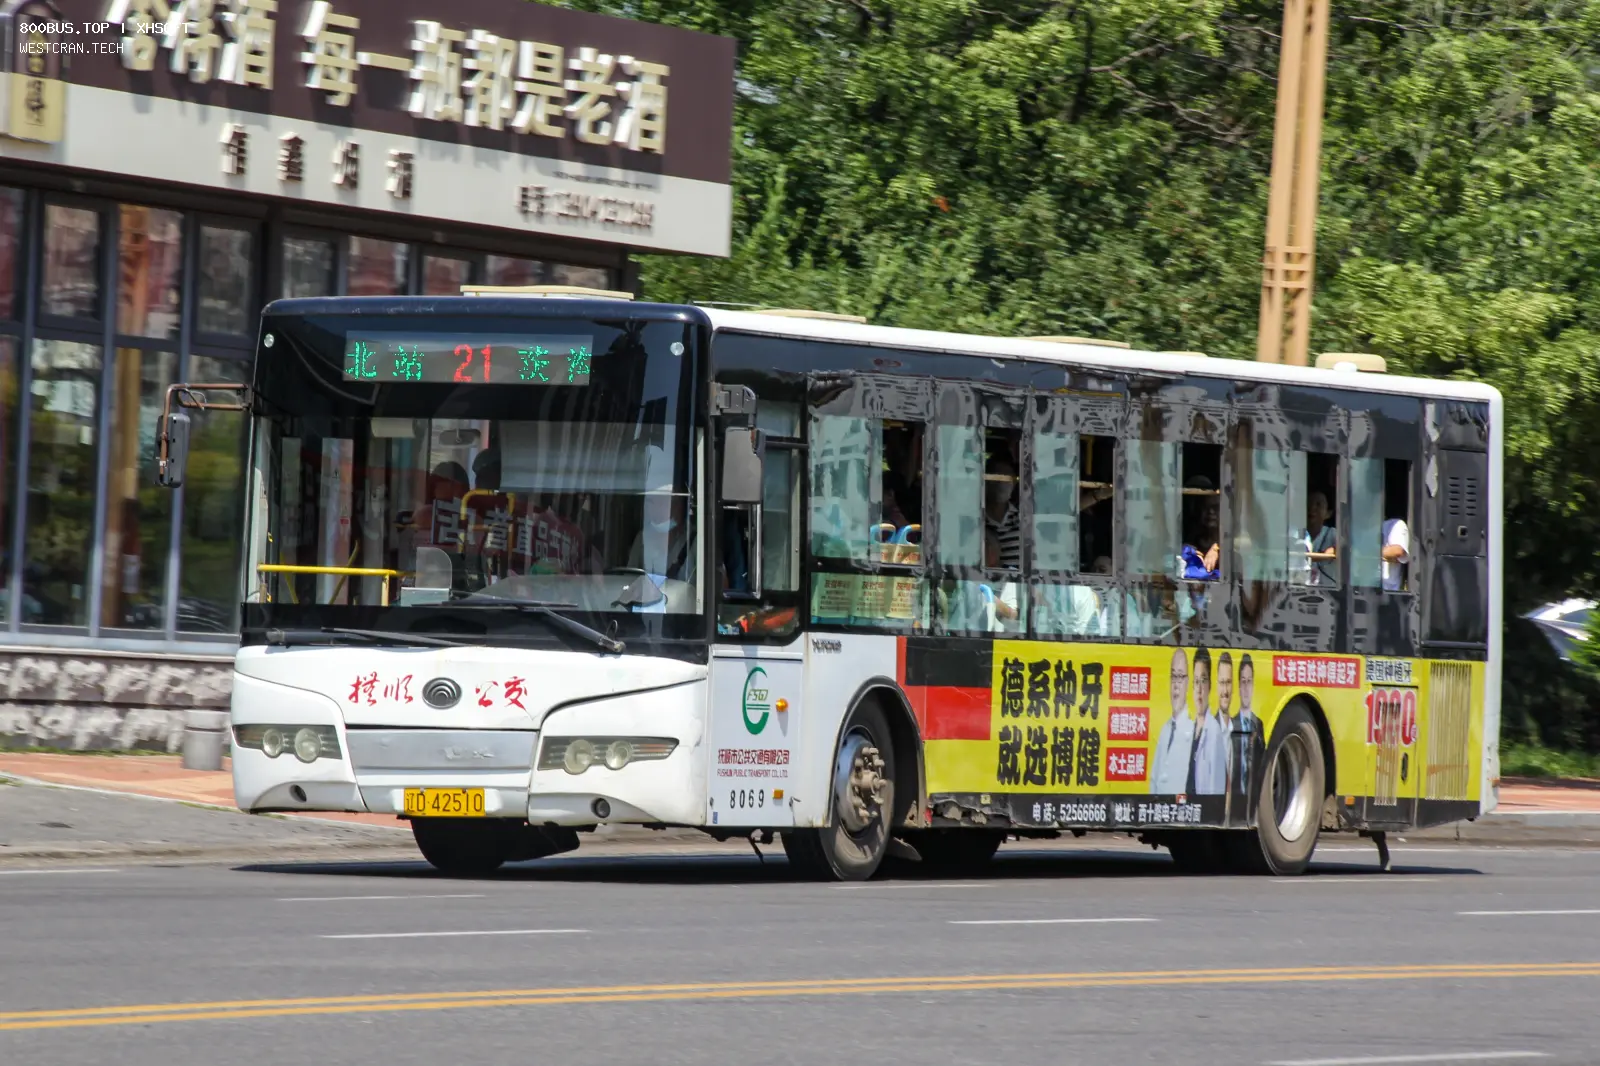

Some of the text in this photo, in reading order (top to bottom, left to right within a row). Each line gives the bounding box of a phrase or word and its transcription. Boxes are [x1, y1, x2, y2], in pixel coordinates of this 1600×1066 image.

[301, 0, 670, 155] 每一瓶都是老酒
[346, 341, 425, 381] 北站
[453, 343, 492, 383] 21
[1111, 672, 1149, 695] 德国品质
[1276, 658, 1357, 685] 让老百姓种得起牙
[475, 675, 528, 712] 公交
[1000, 657, 1104, 720] 德系种牙
[1110, 712, 1148, 735] 德国技术
[717, 748, 790, 765] 抚顺市公共交通有限公司
[997, 724, 1101, 787] 就选博健
[1108, 753, 1146, 776] 本土品牌
[729, 789, 765, 810] 8069
